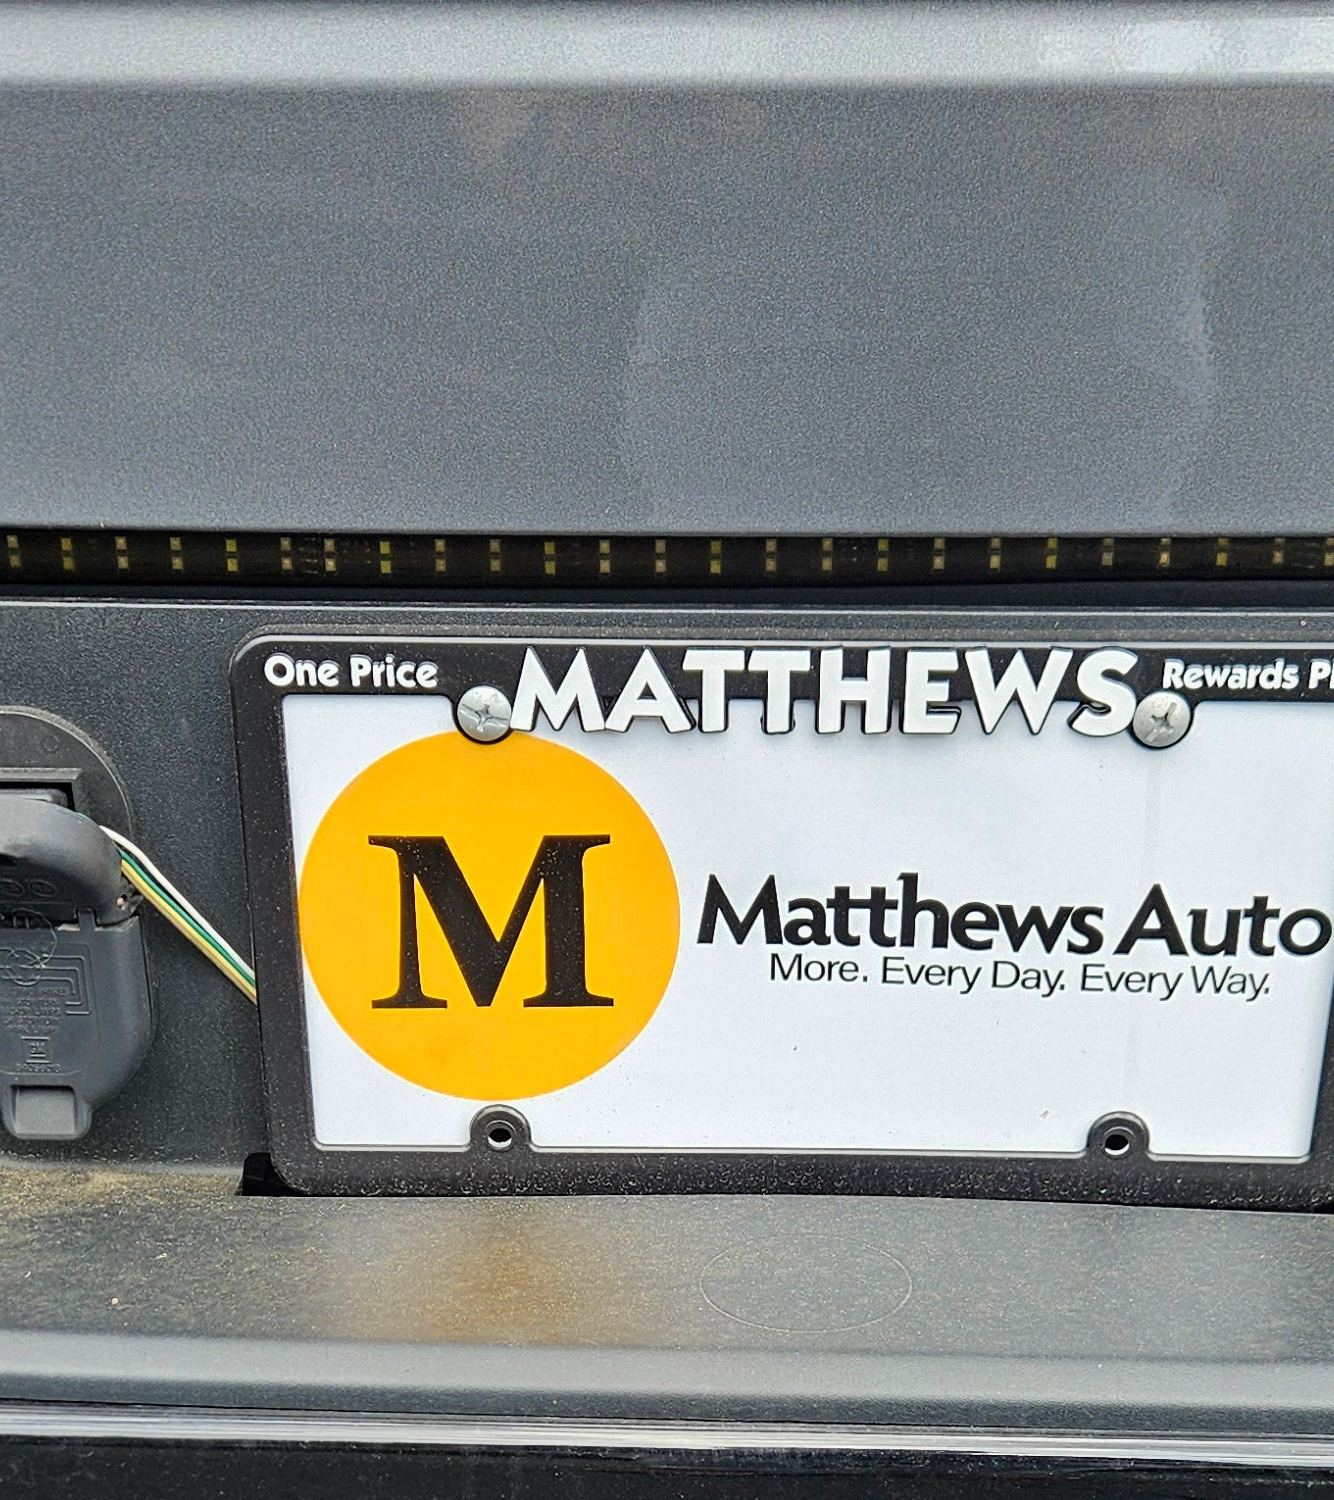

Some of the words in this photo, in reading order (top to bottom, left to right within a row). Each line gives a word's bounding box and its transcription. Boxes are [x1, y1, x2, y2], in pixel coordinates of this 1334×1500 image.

[264, 653, 340, 688] One
[349, 653, 439, 689] Price
[509, 645, 1140, 735] MATTHEWS
[1162, 657, 1300, 690] Rewards
[368, 834, 615, 1009] M
[697, 872, 1105, 955] Matthews
[1112, 883, 1334, 957] Auto
[770, 952, 869, 983] More.
[881, 956, 983, 996] Every
[991, 960, 1067, 999] Day.
[1080, 963, 1185, 1002] Every
[1191, 965, 1271, 1003] Way.
